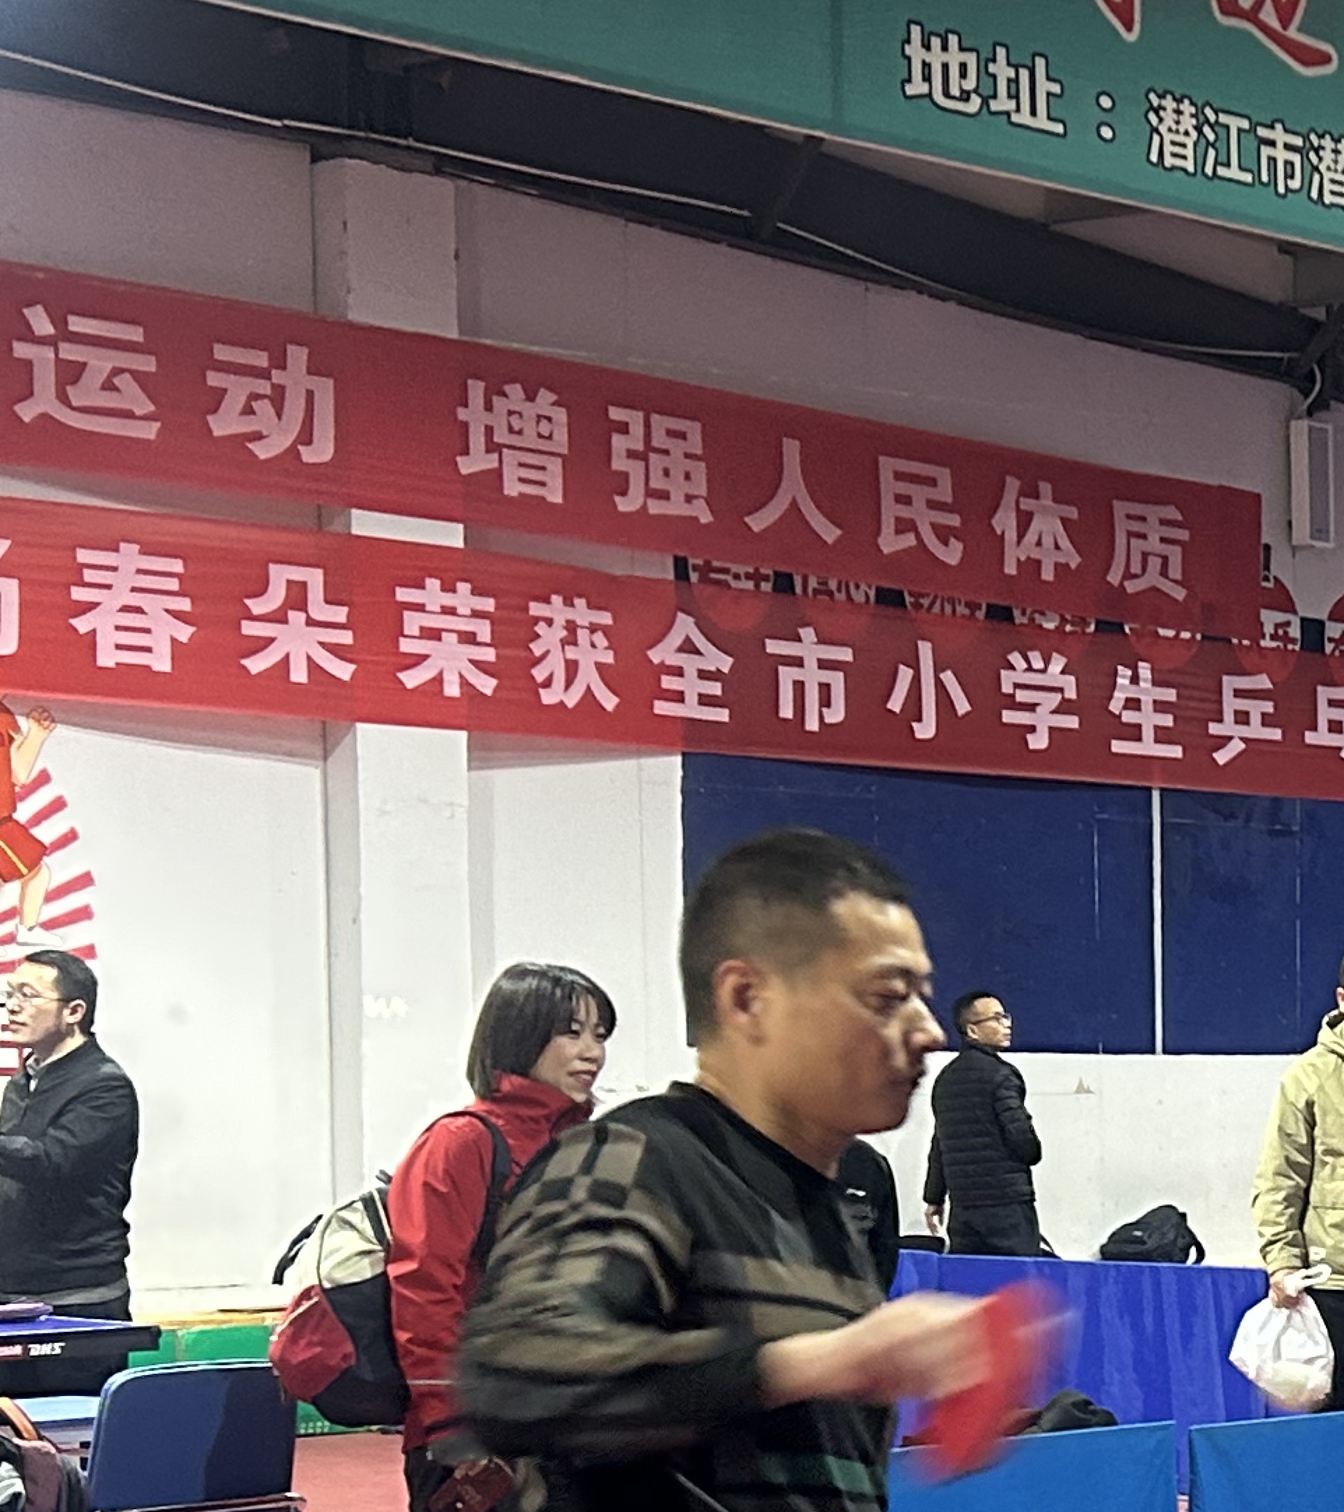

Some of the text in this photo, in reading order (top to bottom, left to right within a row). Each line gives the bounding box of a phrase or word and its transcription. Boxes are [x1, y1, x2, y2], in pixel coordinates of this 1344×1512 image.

[11, 304, 1191, 602] 运动 增强人民体质
